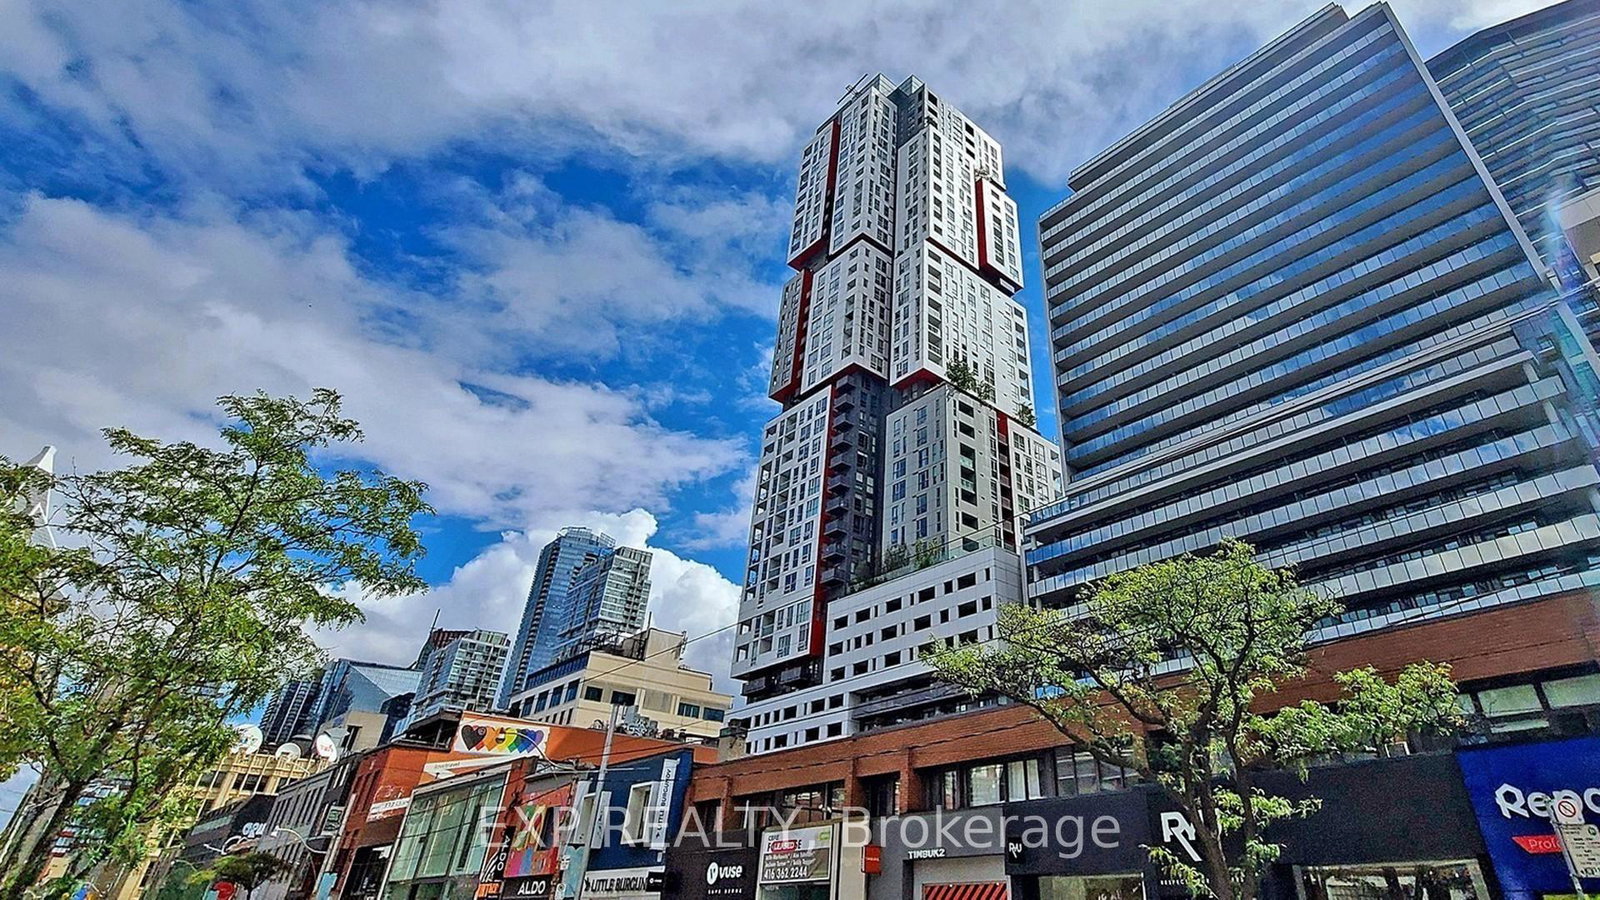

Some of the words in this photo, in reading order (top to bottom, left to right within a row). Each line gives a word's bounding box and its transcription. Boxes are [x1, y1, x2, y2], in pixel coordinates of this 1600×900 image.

[497, 835, 511, 871] ALDO
[790, 865, 808, 878] 2244
[517, 881, 546, 896] ALDO
